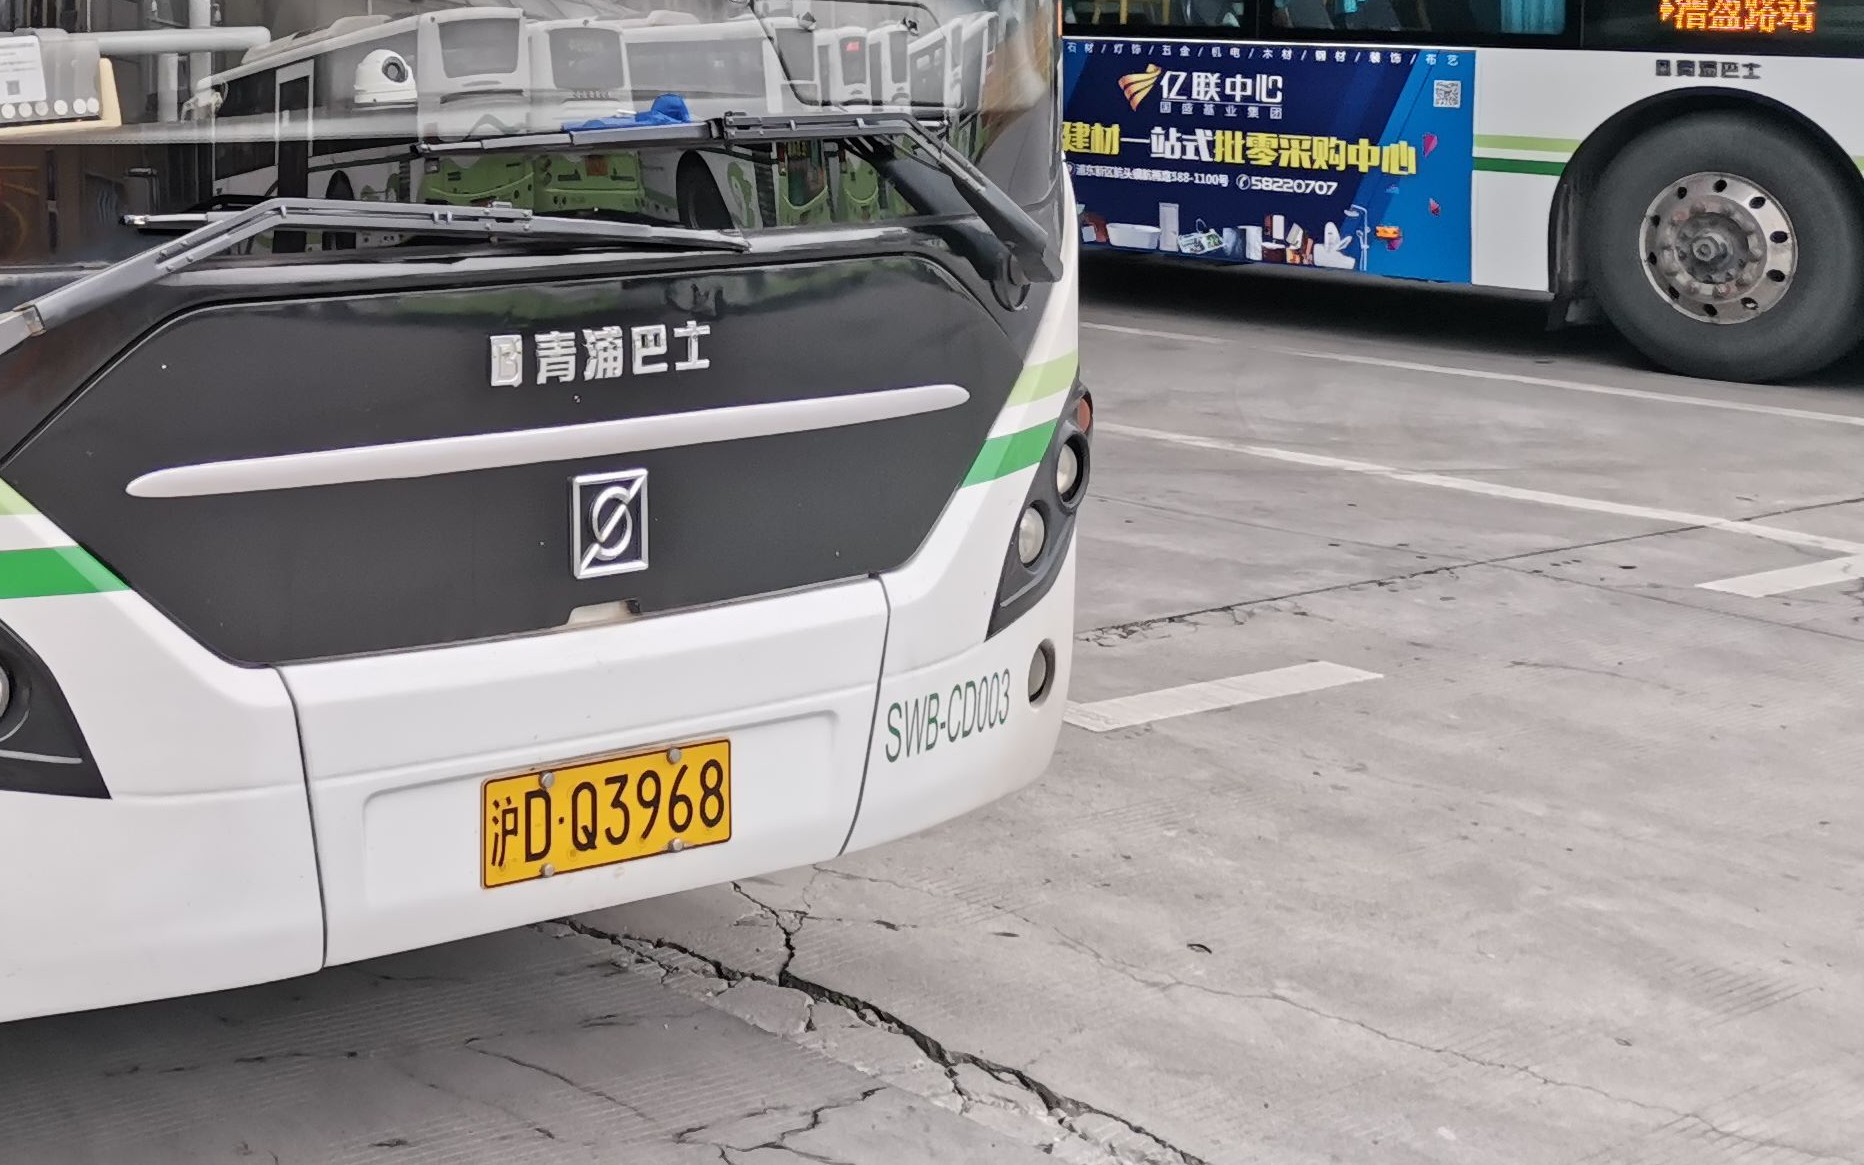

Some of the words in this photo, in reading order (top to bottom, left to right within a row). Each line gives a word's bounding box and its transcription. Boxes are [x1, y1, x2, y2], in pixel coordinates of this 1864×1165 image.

[1160, 71, 1283, 103] 亿联中心
[1160, 101, 1283, 120] 国盛基业集团
[1250, 175, 1339, 196] 58220707
[534, 320, 711, 385] 青浦巴士
[885, 668, 1011, 763] SWB-CD003
